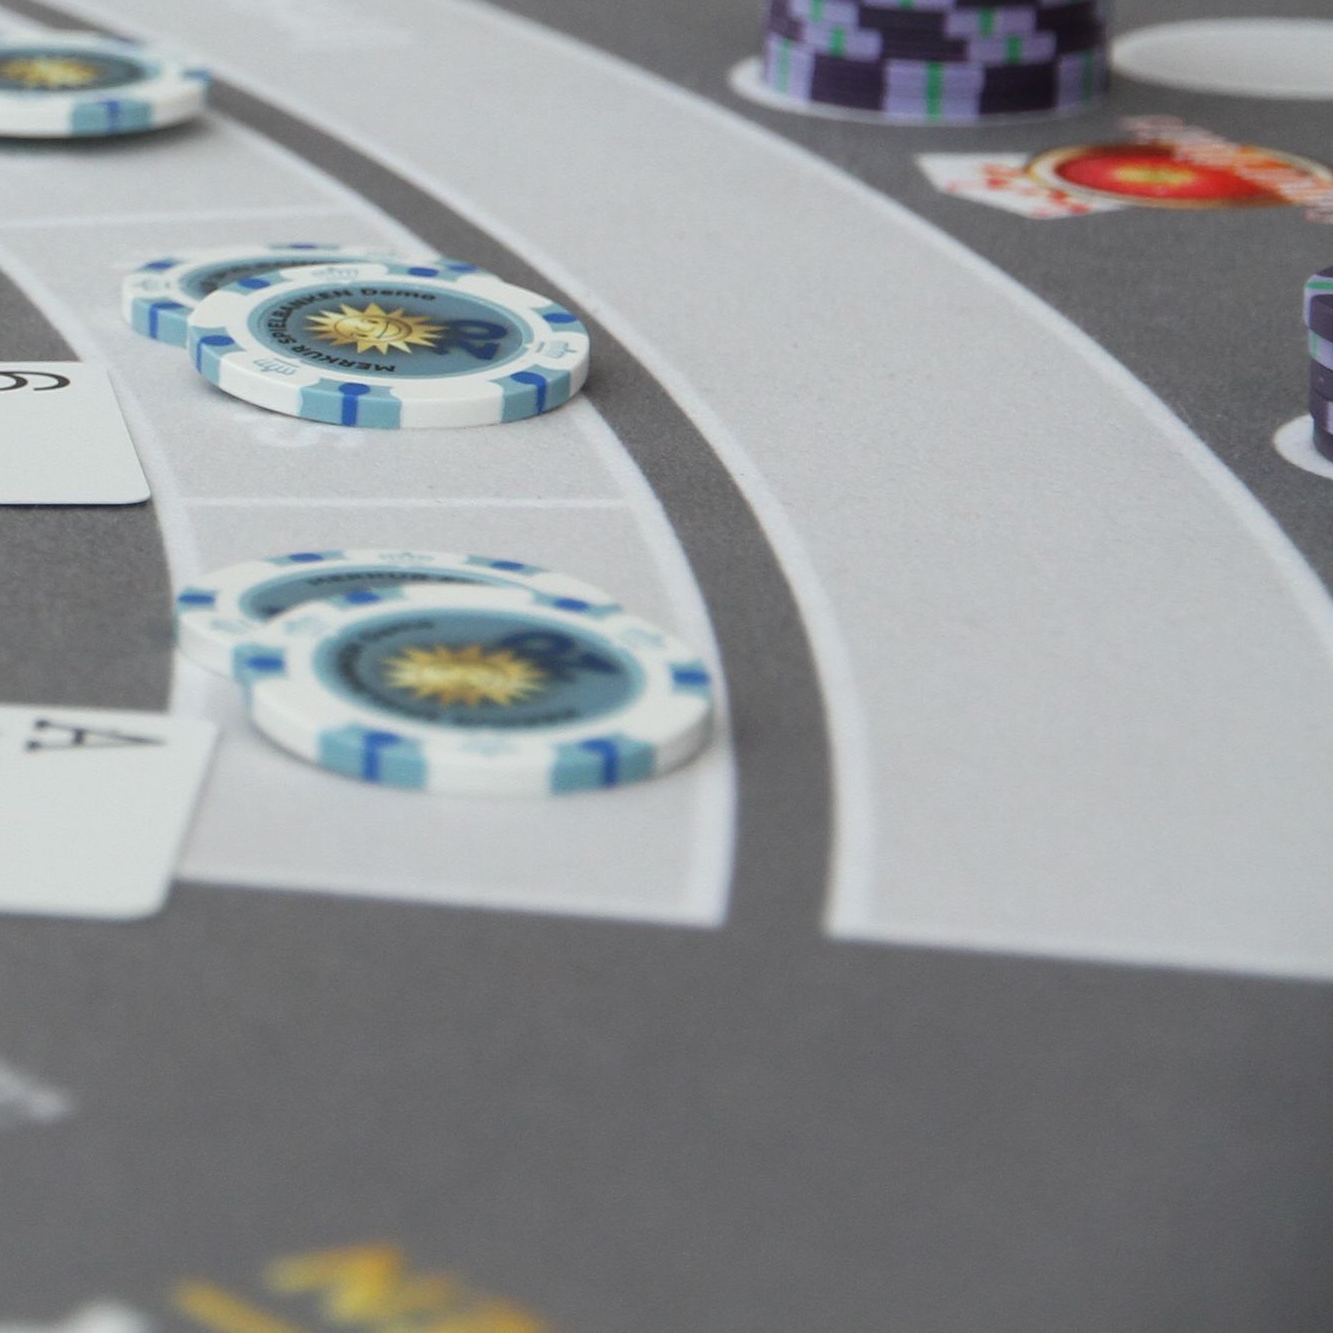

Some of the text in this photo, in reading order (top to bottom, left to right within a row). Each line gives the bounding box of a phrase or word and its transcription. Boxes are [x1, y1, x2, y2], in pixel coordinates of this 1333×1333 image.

[267, 288, 437, 373] MERKUR SPIELBANKEN Demo
[432, 319, 508, 361] 20
[25, 718, 167, 753] A
